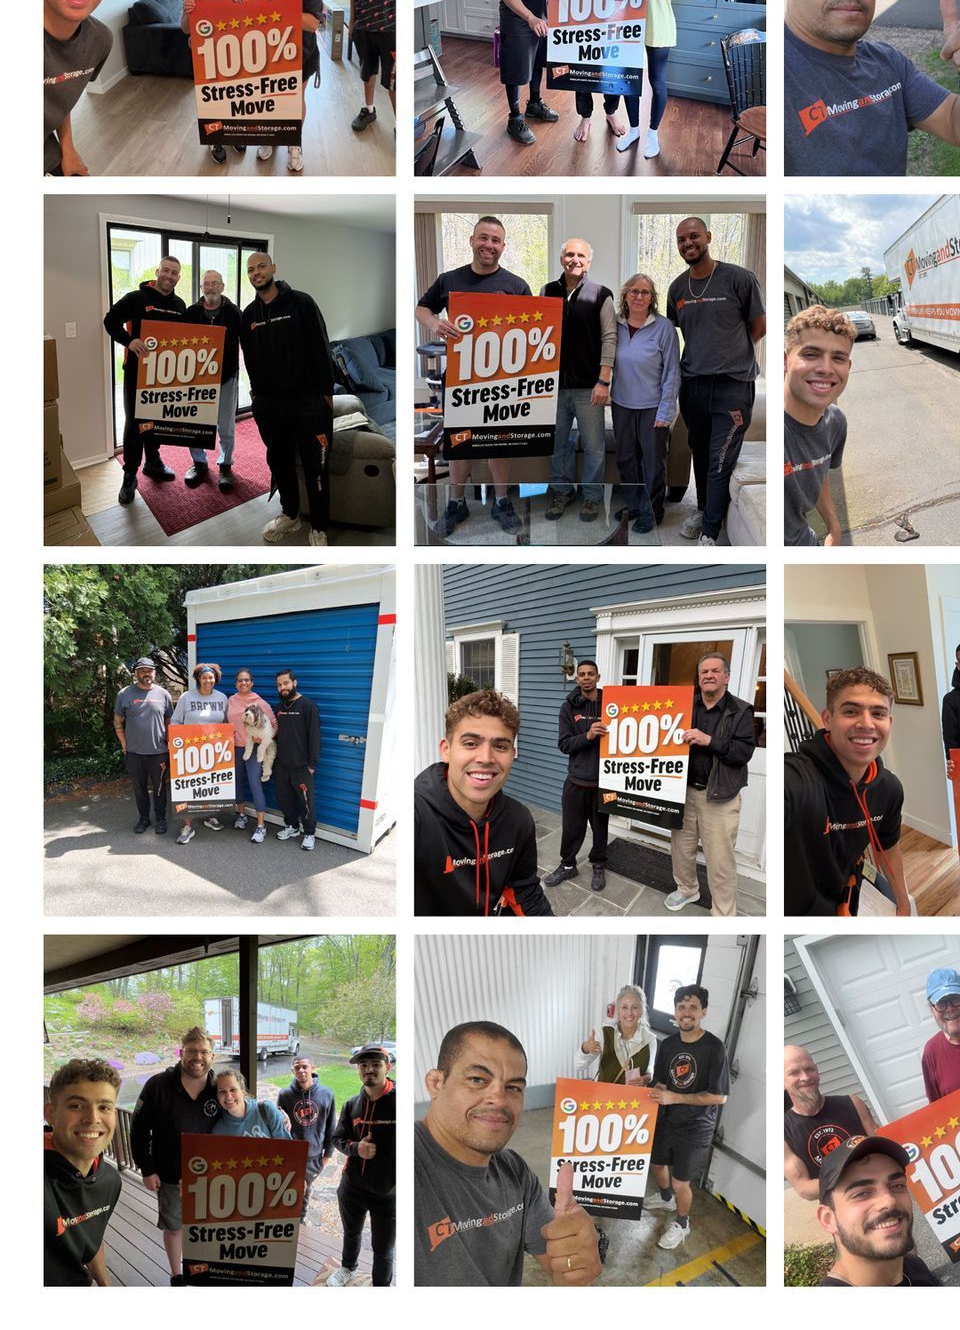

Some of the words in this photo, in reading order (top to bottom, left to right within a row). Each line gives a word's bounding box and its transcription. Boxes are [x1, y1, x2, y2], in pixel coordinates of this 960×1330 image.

[553, 24, 642, 45] Stress-Free
[197, 24, 298, 80] 100%
[578, 45, 620, 61] Move
[201, 75, 298, 103] Stress-Free
[223, 125, 298, 133] MovingandStorage.com
[453, 326, 557, 381] 100%
[142, 348, 219, 386] 100%
[140, 388, 217, 405] Stress-Free
[451, 377, 555, 408] Stress-Free
[471, 432, 552, 441] MovingandStorage.com
[190, 701, 224, 712] BROWN
[604, 713, 686, 755] 100%
[173, 740, 232, 776] 100%
[604, 759, 684, 775] Stress-Free
[175, 770, 233, 791] Stress-Free
[559, 1114, 650, 1153] 100%
[188, 1170, 298, 1220] 100%
[189, 1223, 295, 1243] Stress-Free
[220, 1243, 268, 1260] Move
